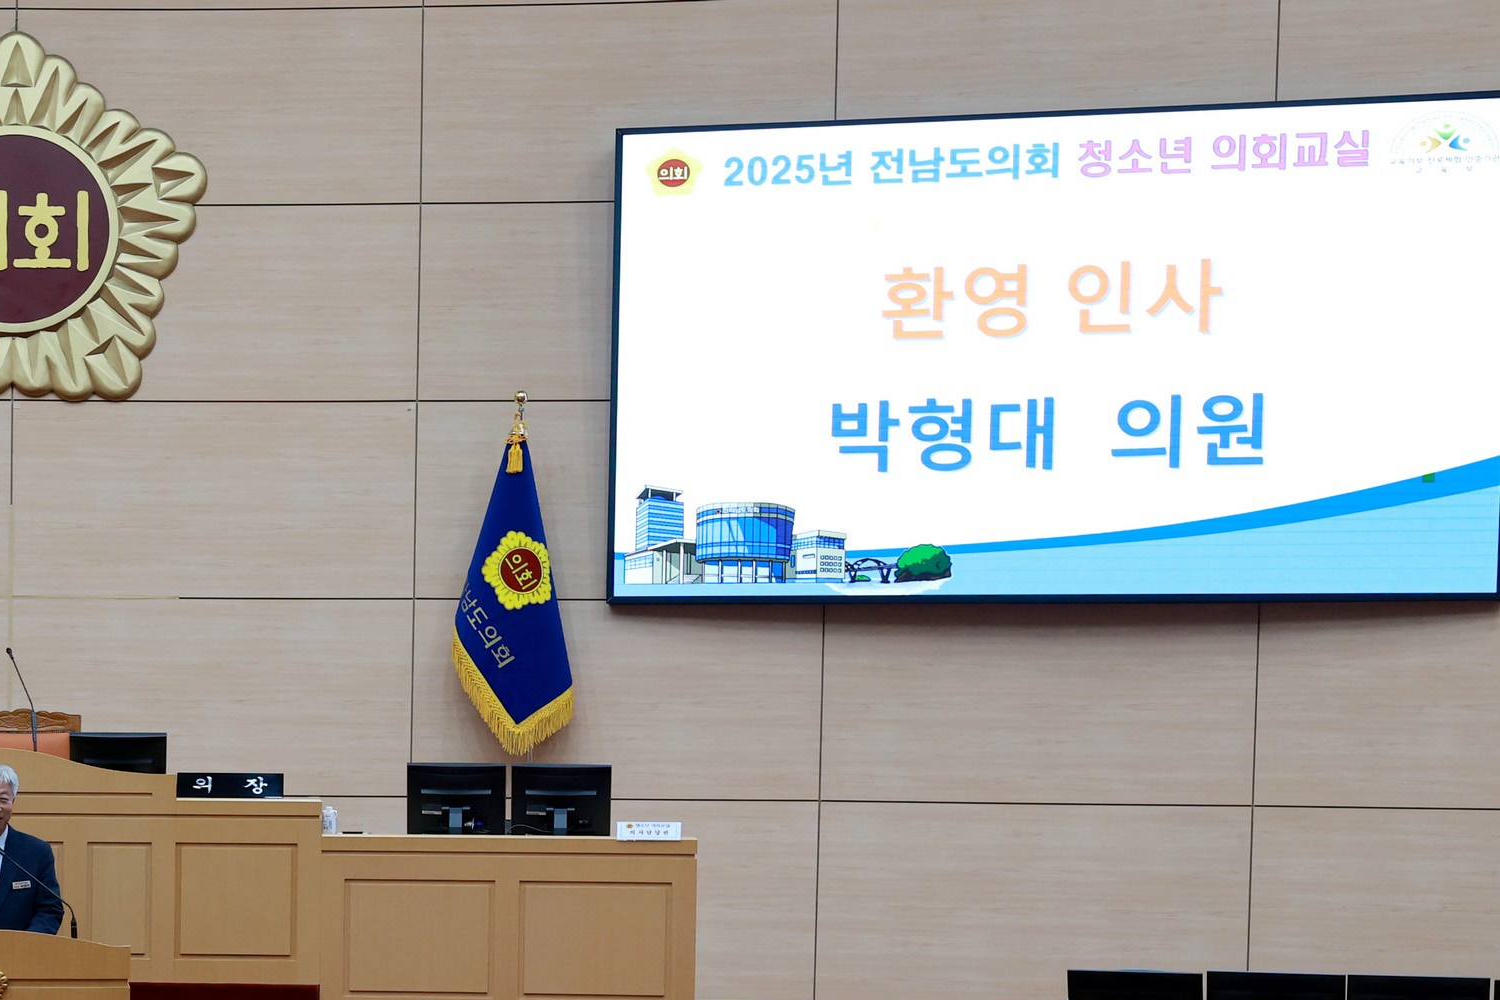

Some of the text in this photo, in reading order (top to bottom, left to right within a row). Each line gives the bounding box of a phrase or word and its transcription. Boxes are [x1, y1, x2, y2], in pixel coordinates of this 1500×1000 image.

[658, 166, 688, 182] 의회
[723, 150, 853, 187] 2025년
[870, 142, 1060, 185] 전남도의회
[1078, 136, 1192, 178] 청소년
[1211, 129, 1370, 172] 의회교실
[882, 258, 1223, 340] 환영 인사
[831, 392, 1266, 474] 박형대 의원
[505, 554, 538, 590] 의회
